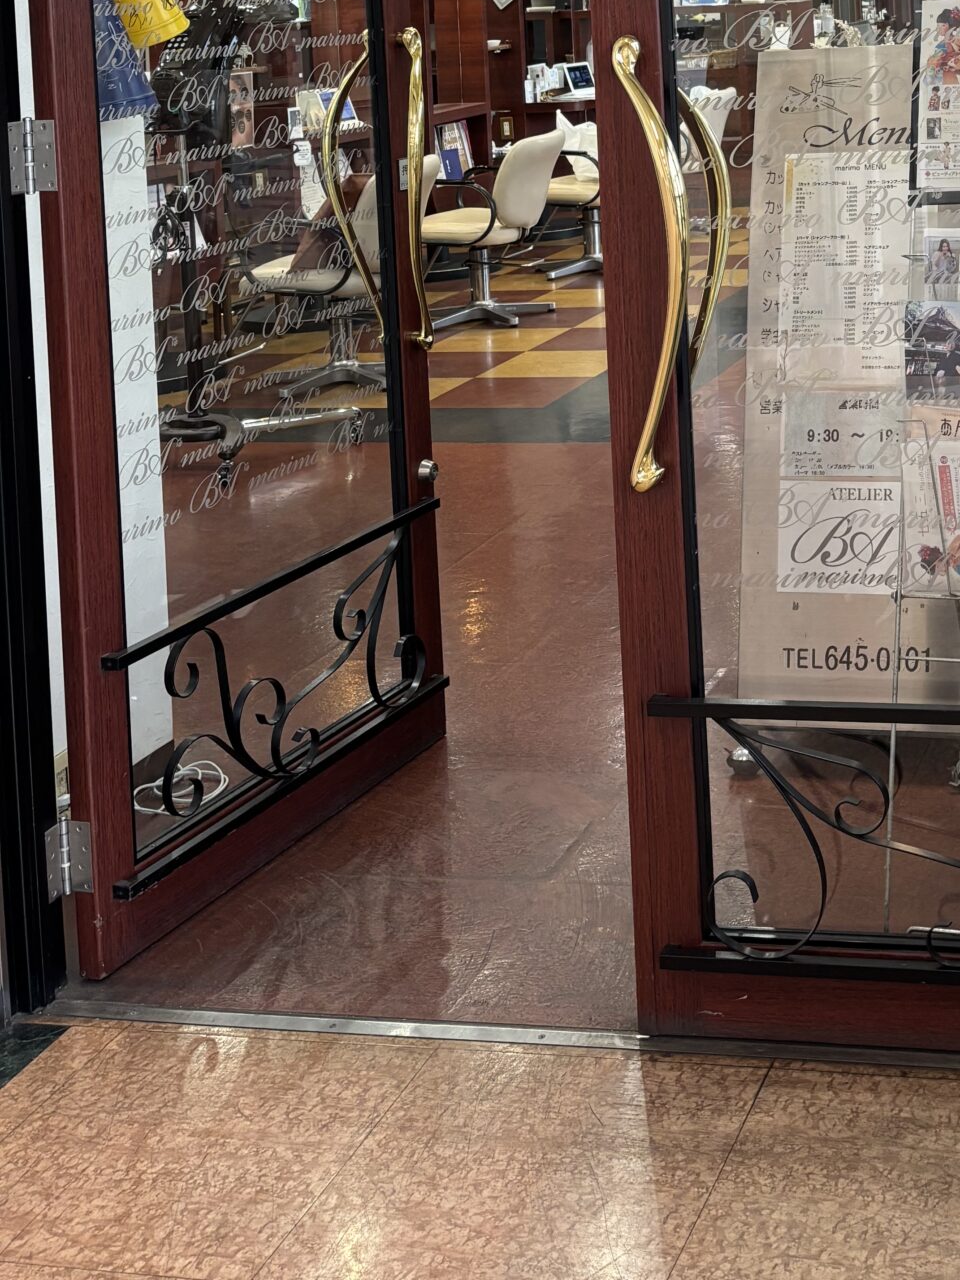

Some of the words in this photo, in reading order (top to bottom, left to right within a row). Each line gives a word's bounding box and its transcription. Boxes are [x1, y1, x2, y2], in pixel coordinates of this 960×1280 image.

[160, 40, 239, 64] marimo
[247, 17, 296, 55] BA
[723, 3, 818, 52] BA
[167, 71, 225, 113] BA
[102, 128, 162, 177] BA
[864, 163, 887, 171] MENU
[175, 170, 226, 214] BA
[232, 176, 306, 203] marimo
[180, 267, 234, 312] BA
[177, 331, 255, 367] marimo
[263, 295, 311, 339] BA
[185, 364, 240, 414] BA
[807, 428, 840, 443] 9:30
[190, 462, 246, 513] BA
[829, 487, 894, 502] ATELIER
[791, 508, 895, 568] BA
